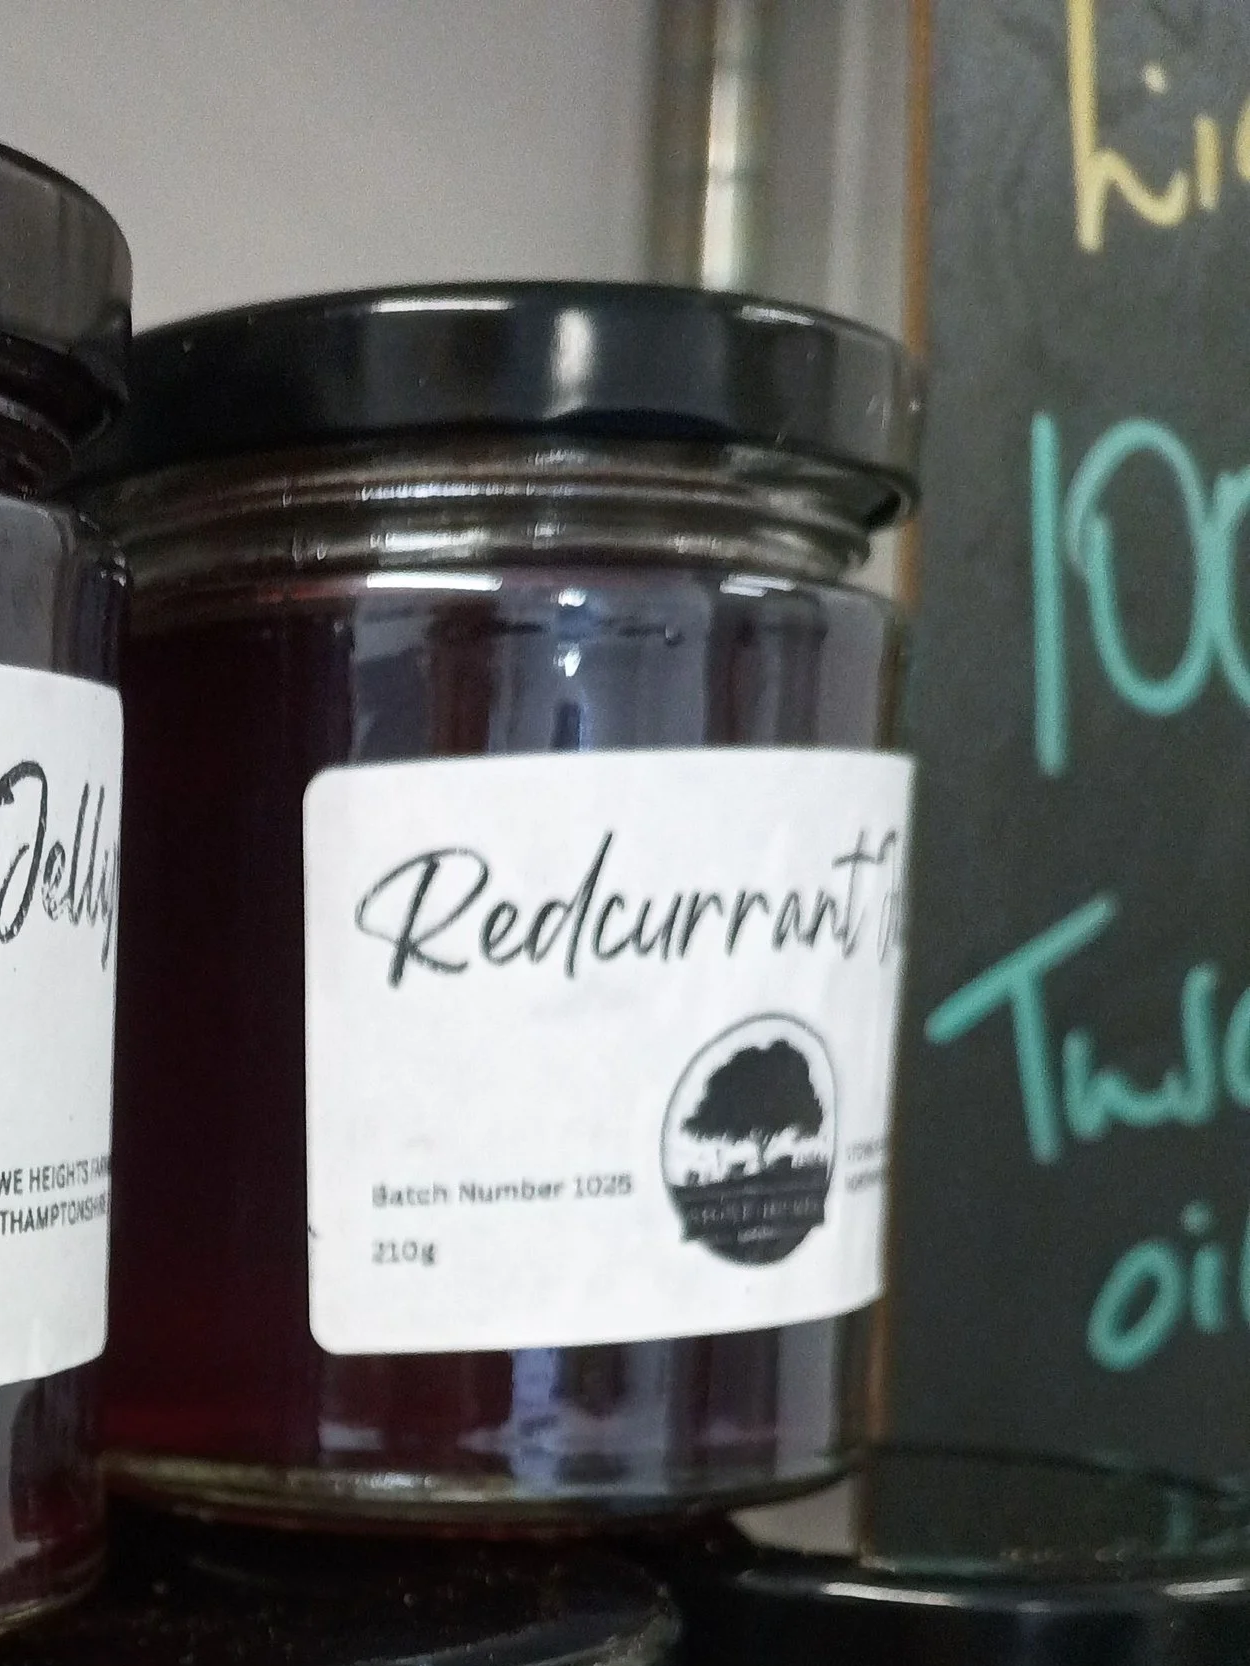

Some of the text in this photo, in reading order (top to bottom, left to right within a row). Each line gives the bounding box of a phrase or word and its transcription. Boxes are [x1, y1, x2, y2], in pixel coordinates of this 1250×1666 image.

[355, 829, 875, 989] Redcurrant
[28, 1158, 90, 1193] HEIGHTS
[371, 1172, 634, 1209] Batch Number 1025
[372, 1239, 437, 1268] 210g
